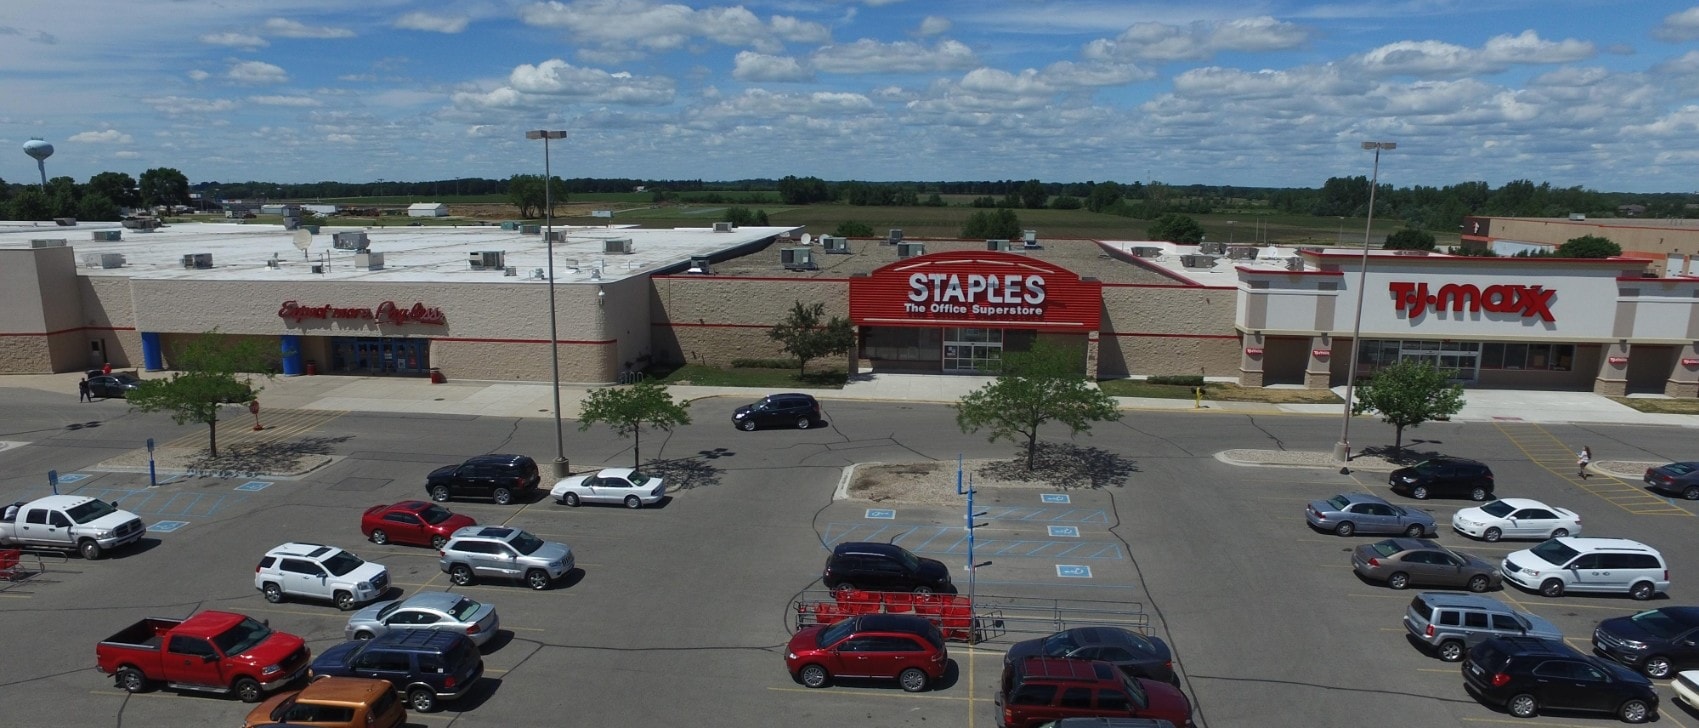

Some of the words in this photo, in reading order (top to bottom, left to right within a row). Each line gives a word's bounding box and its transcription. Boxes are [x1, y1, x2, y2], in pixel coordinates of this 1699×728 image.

[908, 272, 1045, 304] STAPLES
[904, 303, 926, 313] The
[930, 303, 967, 314] Office
[972, 304, 1043, 316] Superstore
